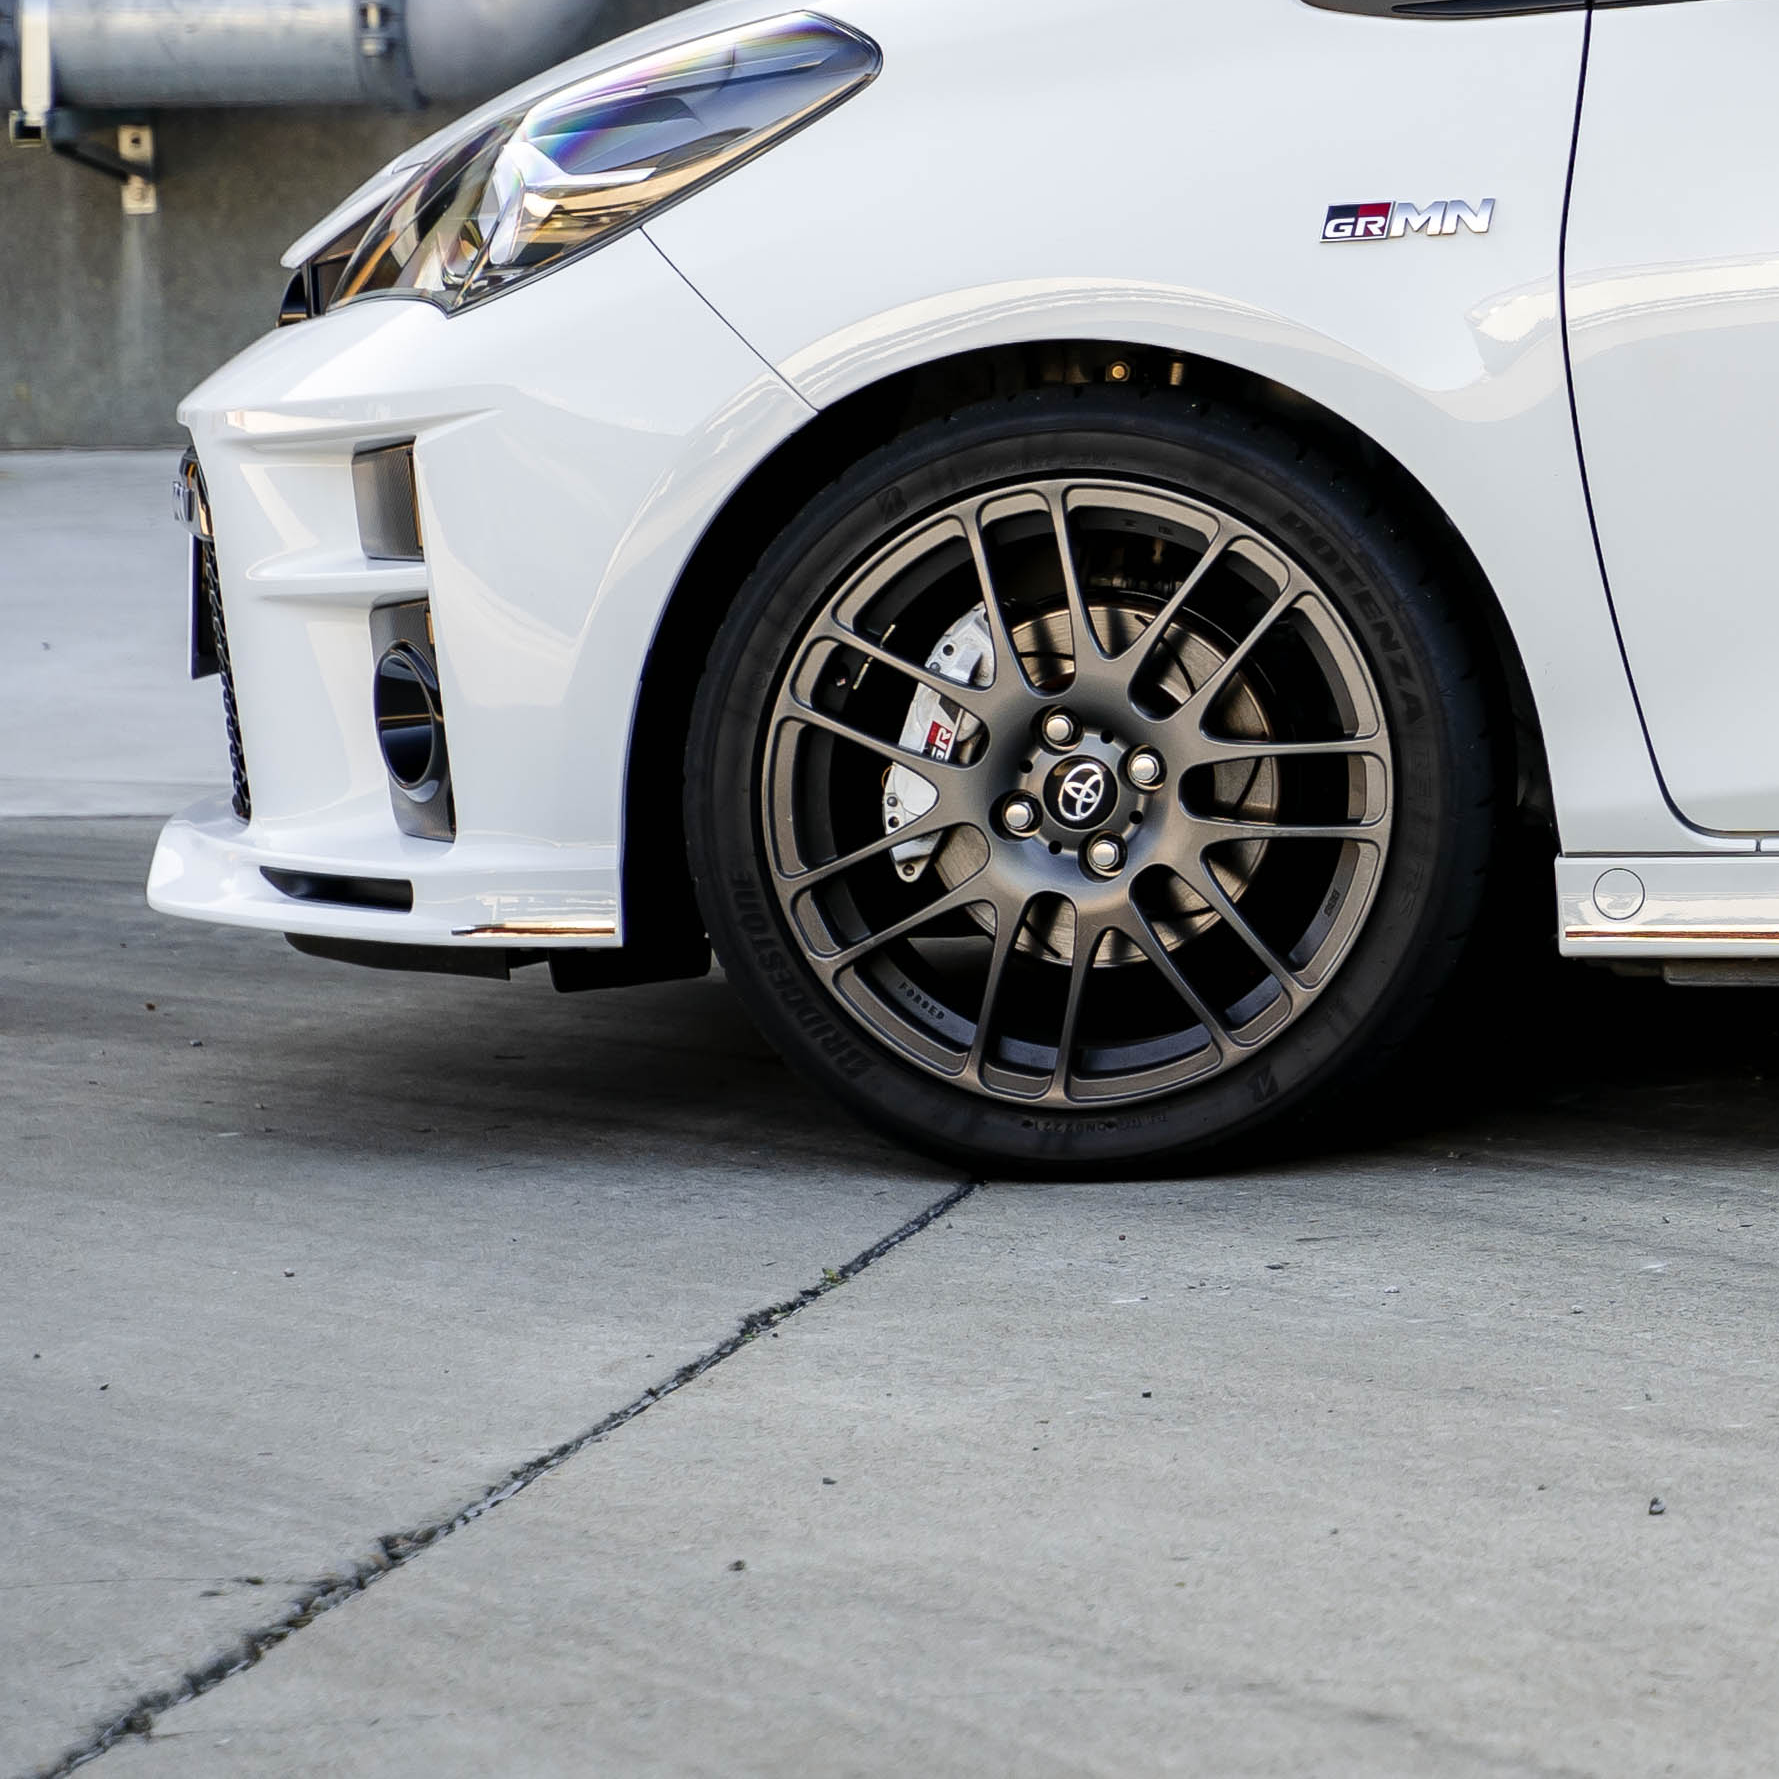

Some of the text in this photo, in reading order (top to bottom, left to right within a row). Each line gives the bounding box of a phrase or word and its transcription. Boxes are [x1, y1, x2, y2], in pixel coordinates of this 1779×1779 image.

[1278, 510, 1431, 720] POTENZA
[730, 868, 874, 1079] BRIDGESTONE
[898, 982, 945, 1020] FORGED
